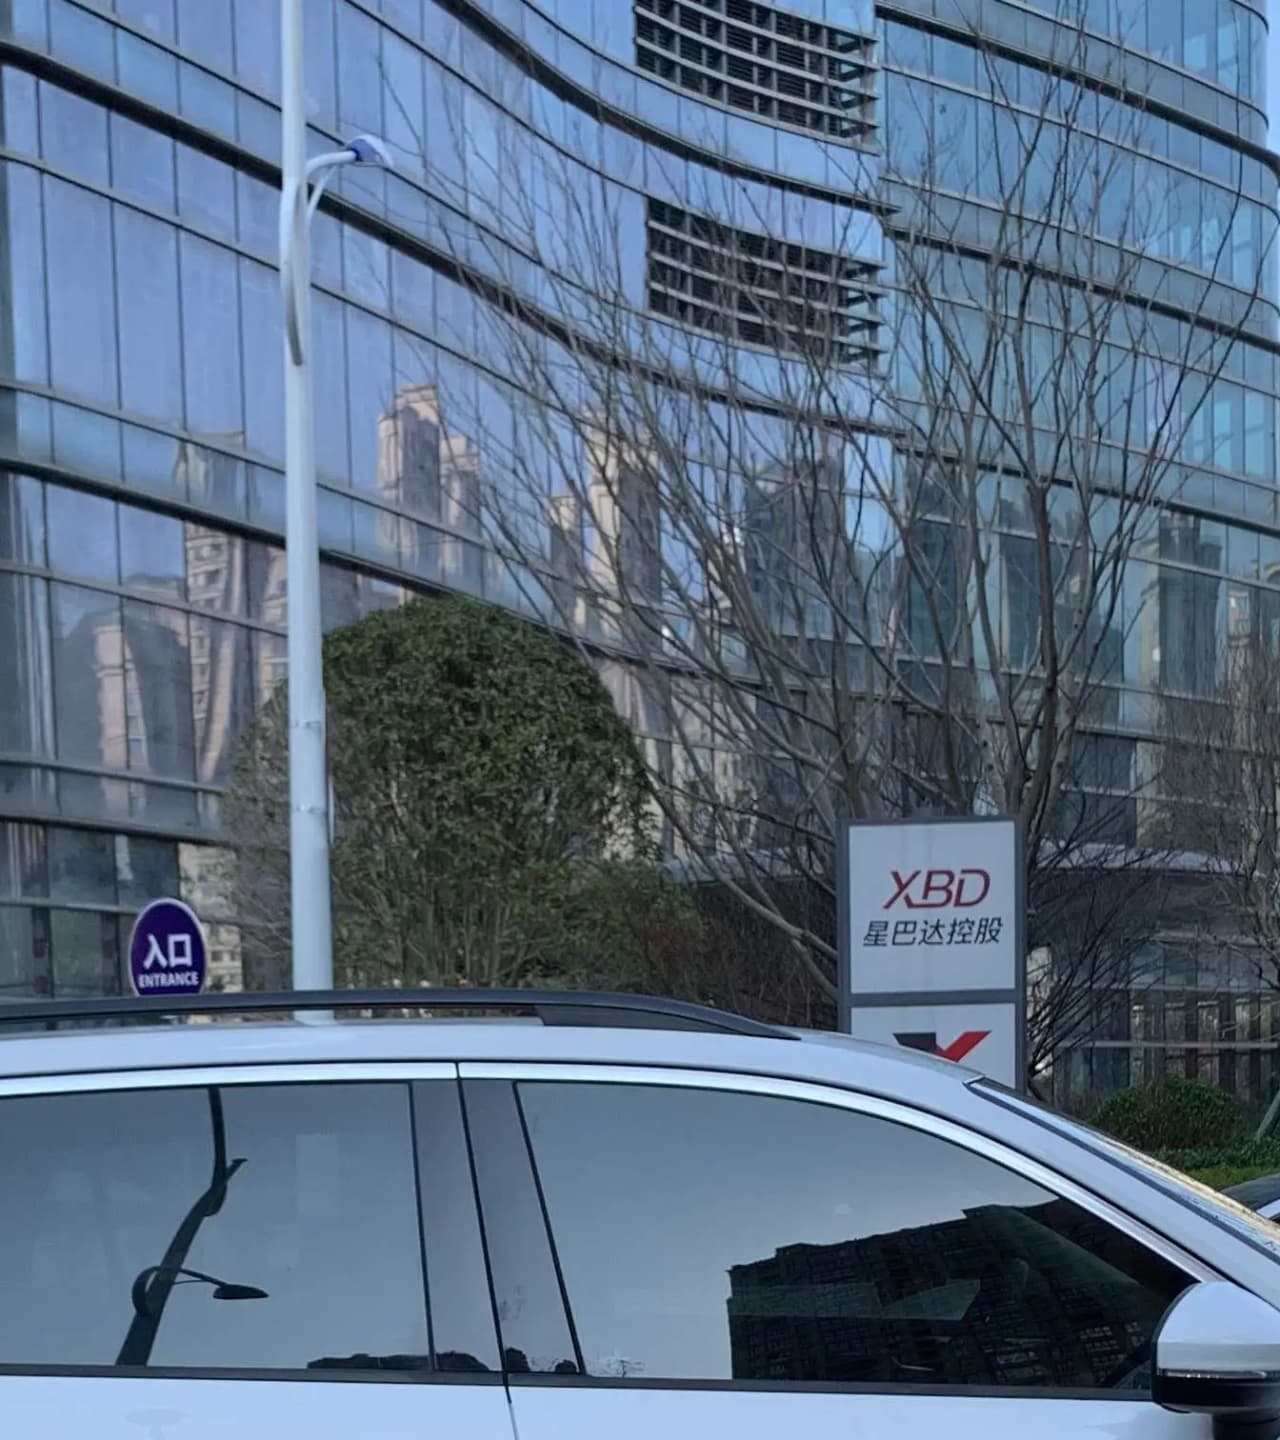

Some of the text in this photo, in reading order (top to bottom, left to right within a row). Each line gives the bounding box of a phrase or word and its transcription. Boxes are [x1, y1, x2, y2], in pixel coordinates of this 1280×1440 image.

[882, 868, 991, 910] XBD
[862, 917, 1003, 947] 星巴达控股
[143, 933, 192, 970] 入口
[138, 971, 199, 988] ENTRANCE
